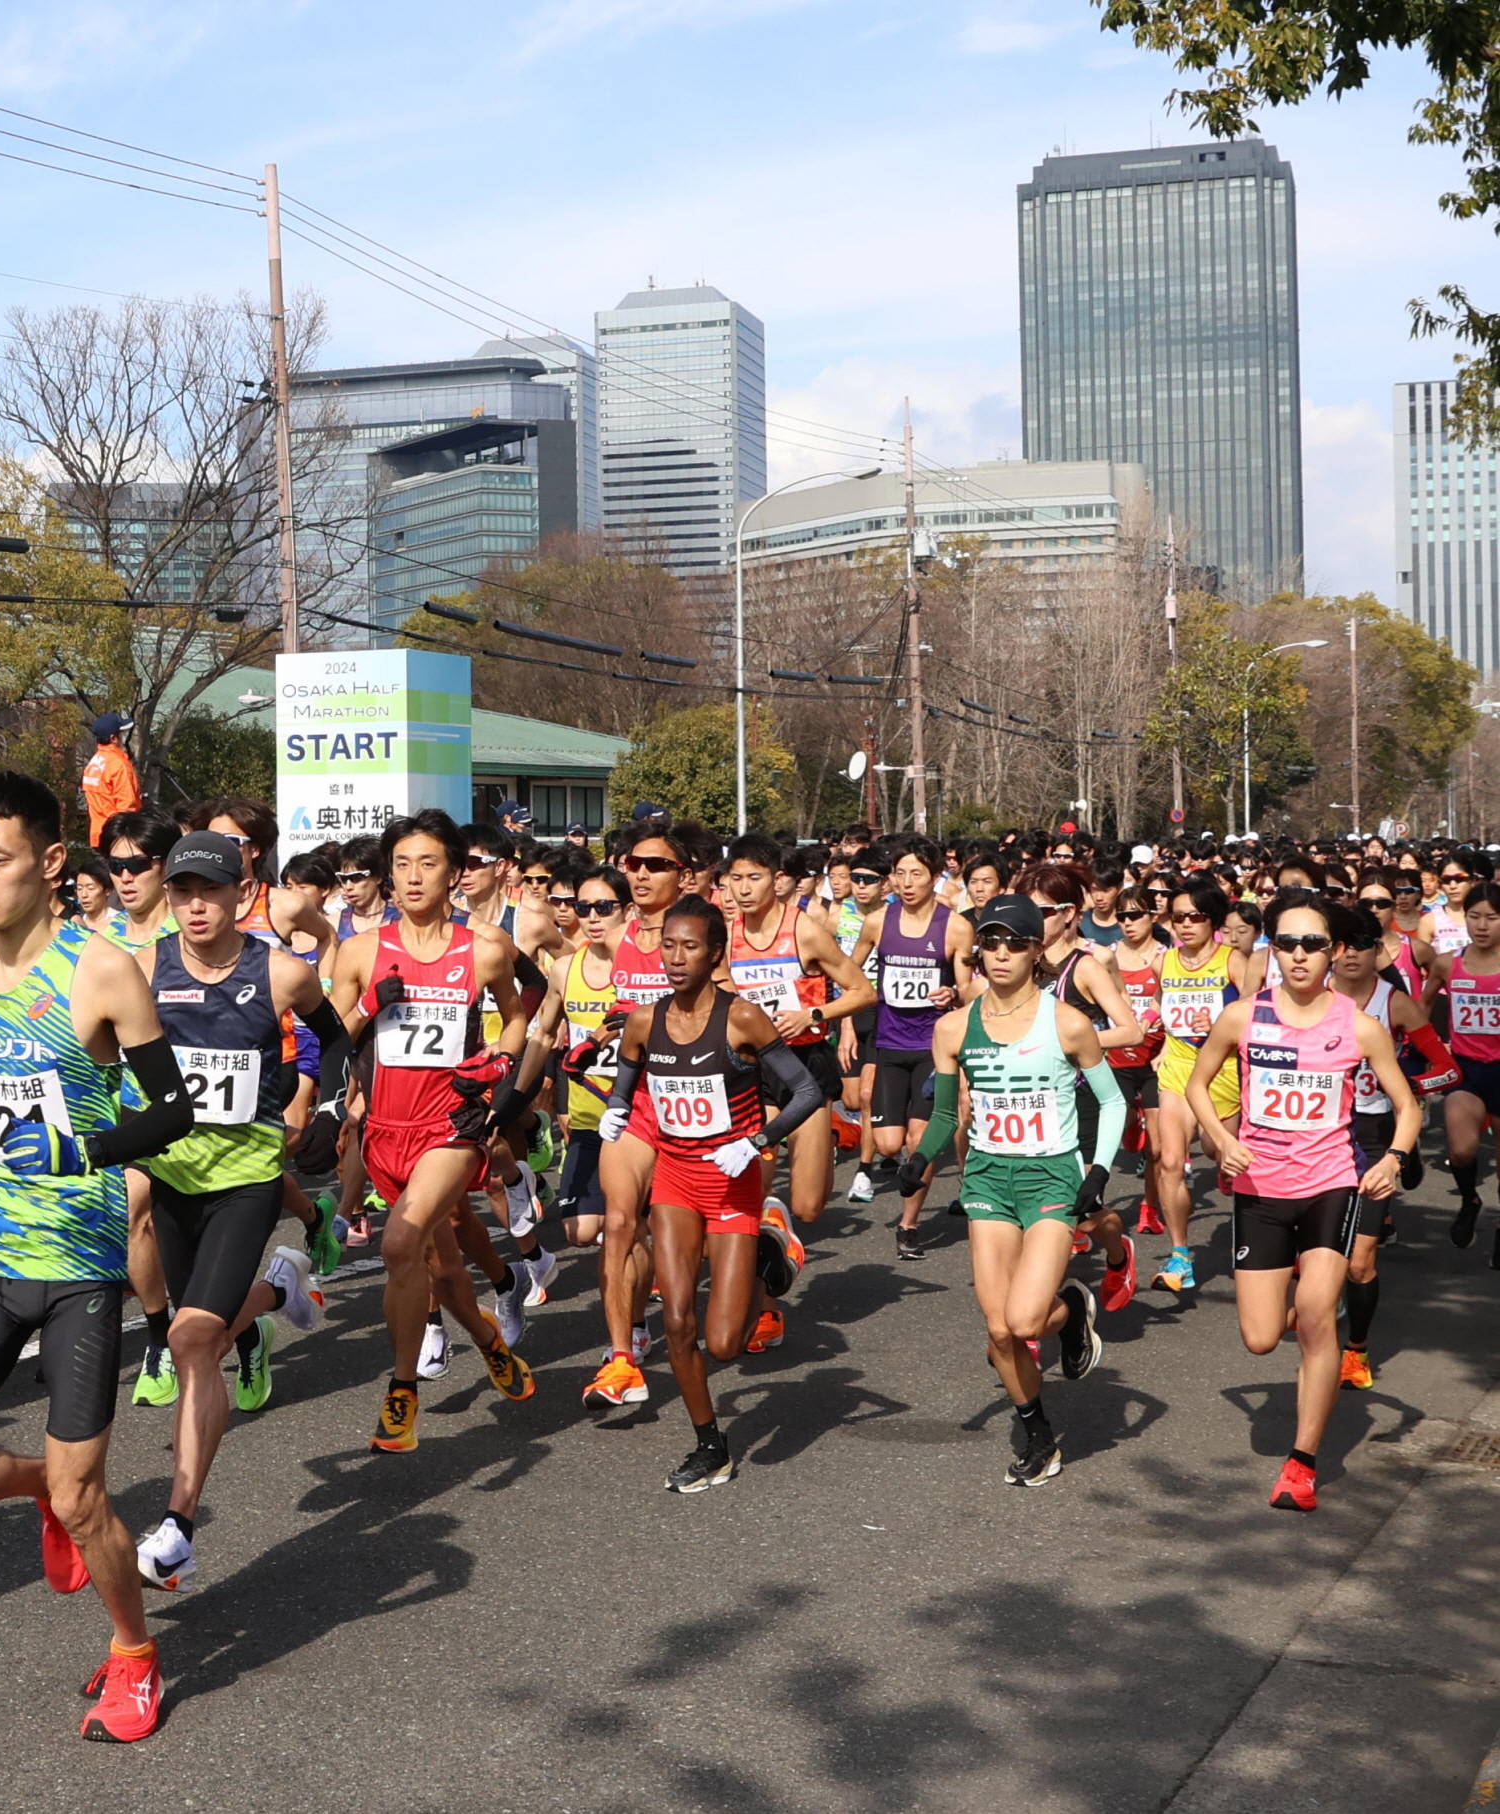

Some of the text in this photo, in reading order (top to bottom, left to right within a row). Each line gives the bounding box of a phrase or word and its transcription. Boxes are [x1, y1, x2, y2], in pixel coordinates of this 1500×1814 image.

[325, 662, 357, 675] 2024
[286, 732, 398, 761] START
[316, 805, 395, 829] 奥村組
[289, 832, 333, 841] OKUMURA
[744, 967, 784, 981] NTN
[900, 969, 933, 980] 奥村組
[1162, 976, 1225, 989] SUZUKI
[162, 992, 202, 1001] Yakult
[747, 983, 788, 1001] 奥村組
[891, 981, 930, 1000] 120
[1178, 993, 1215, 1004] 奥村組
[404, 1005, 457, 1022] 奥村組
[1459, 1006, 1500, 1028] 213
[399, 1024, 444, 1056] 72
[189, 1051, 250, 1071] 奥村組
[649, 1053, 677, 1065] DENSO
[1248, 1047, 1298, 1062] てんまや
[665, 1079, 714, 1094] 奥村組
[1278, 1072, 1333, 1089] 奥村組
[184, 1073, 235, 1112] 21
[992, 1093, 1046, 1110] 奥村組
[1263, 1088, 1327, 1121] 202
[659, 1096, 713, 1127] 209
[985, 1111, 1045, 1143] 201
